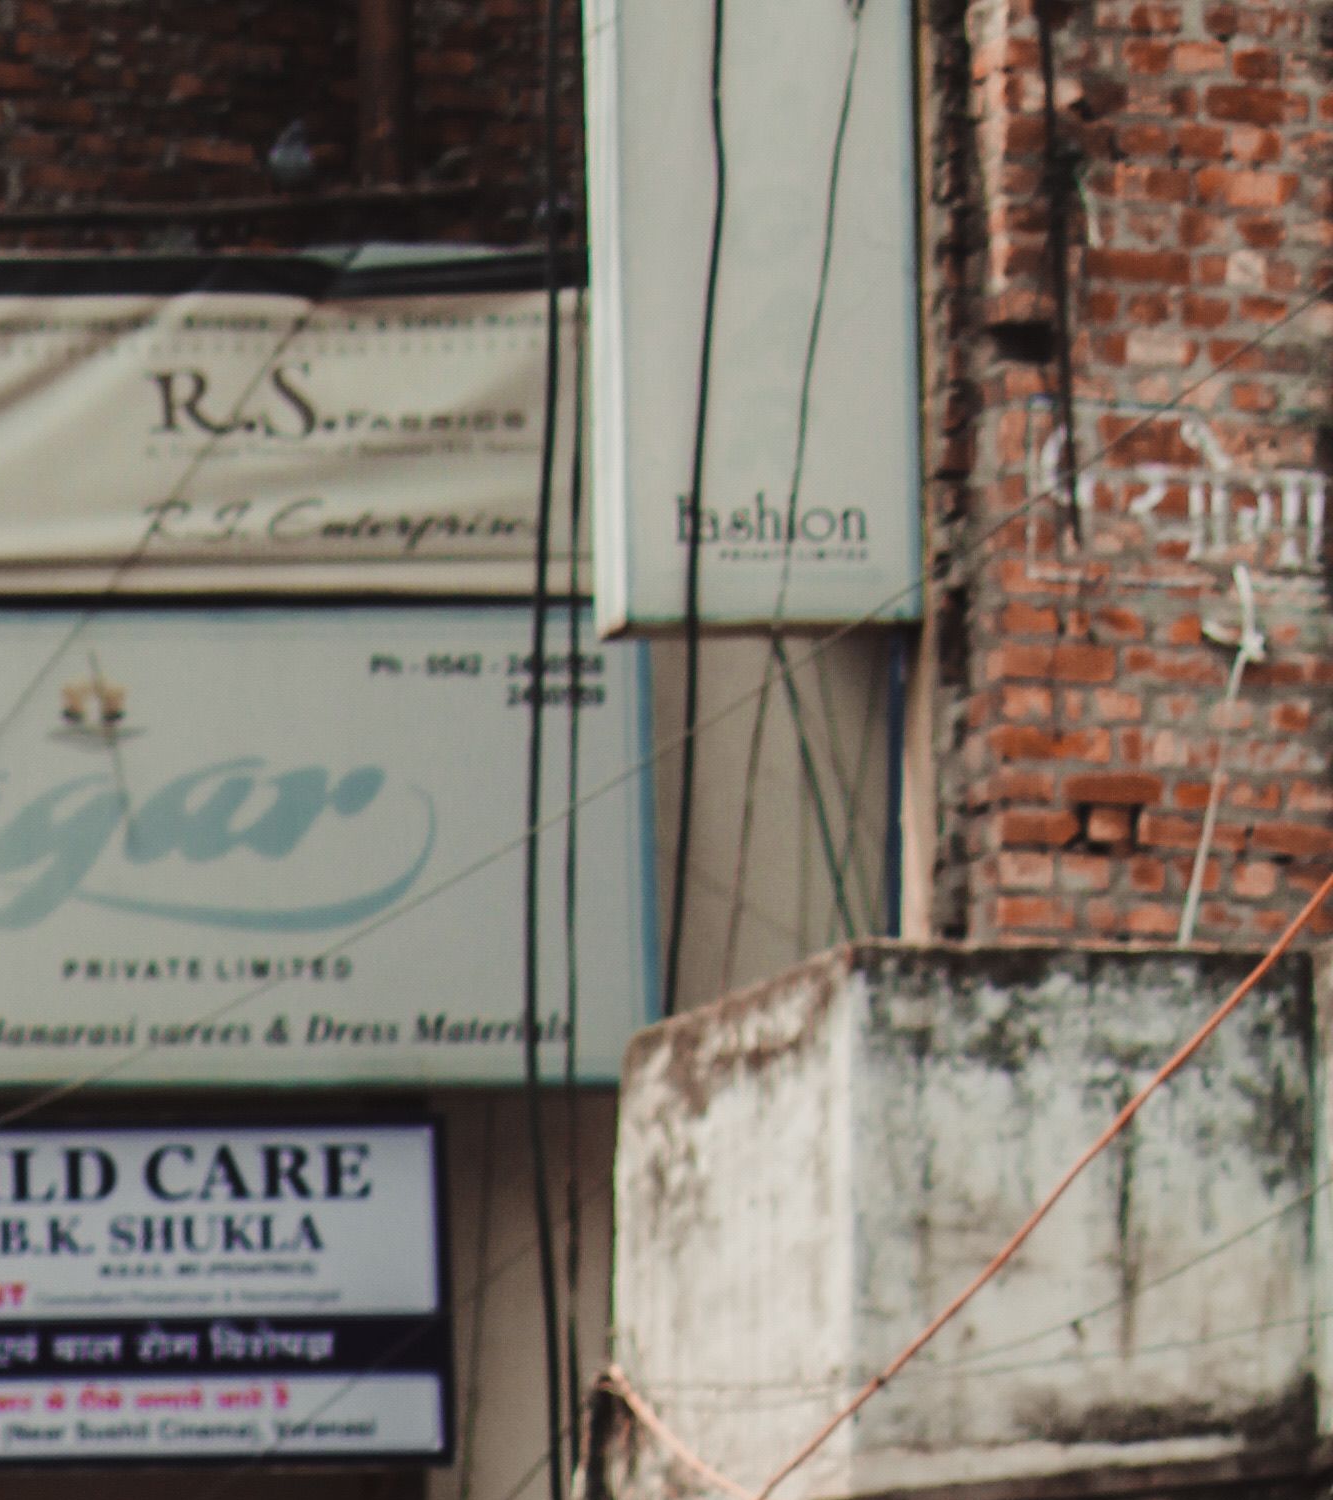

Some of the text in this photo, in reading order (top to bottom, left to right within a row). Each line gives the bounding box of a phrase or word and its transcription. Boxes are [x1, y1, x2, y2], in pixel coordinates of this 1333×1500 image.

[676, 489, 868, 543] Fashon
[60, 956, 355, 983] PRIVATE LIMITED
[303, 1015, 401, 1048] Dress
[143, 1142, 375, 1202] CARE
[108, 1211, 326, 1255] SHUKLA
